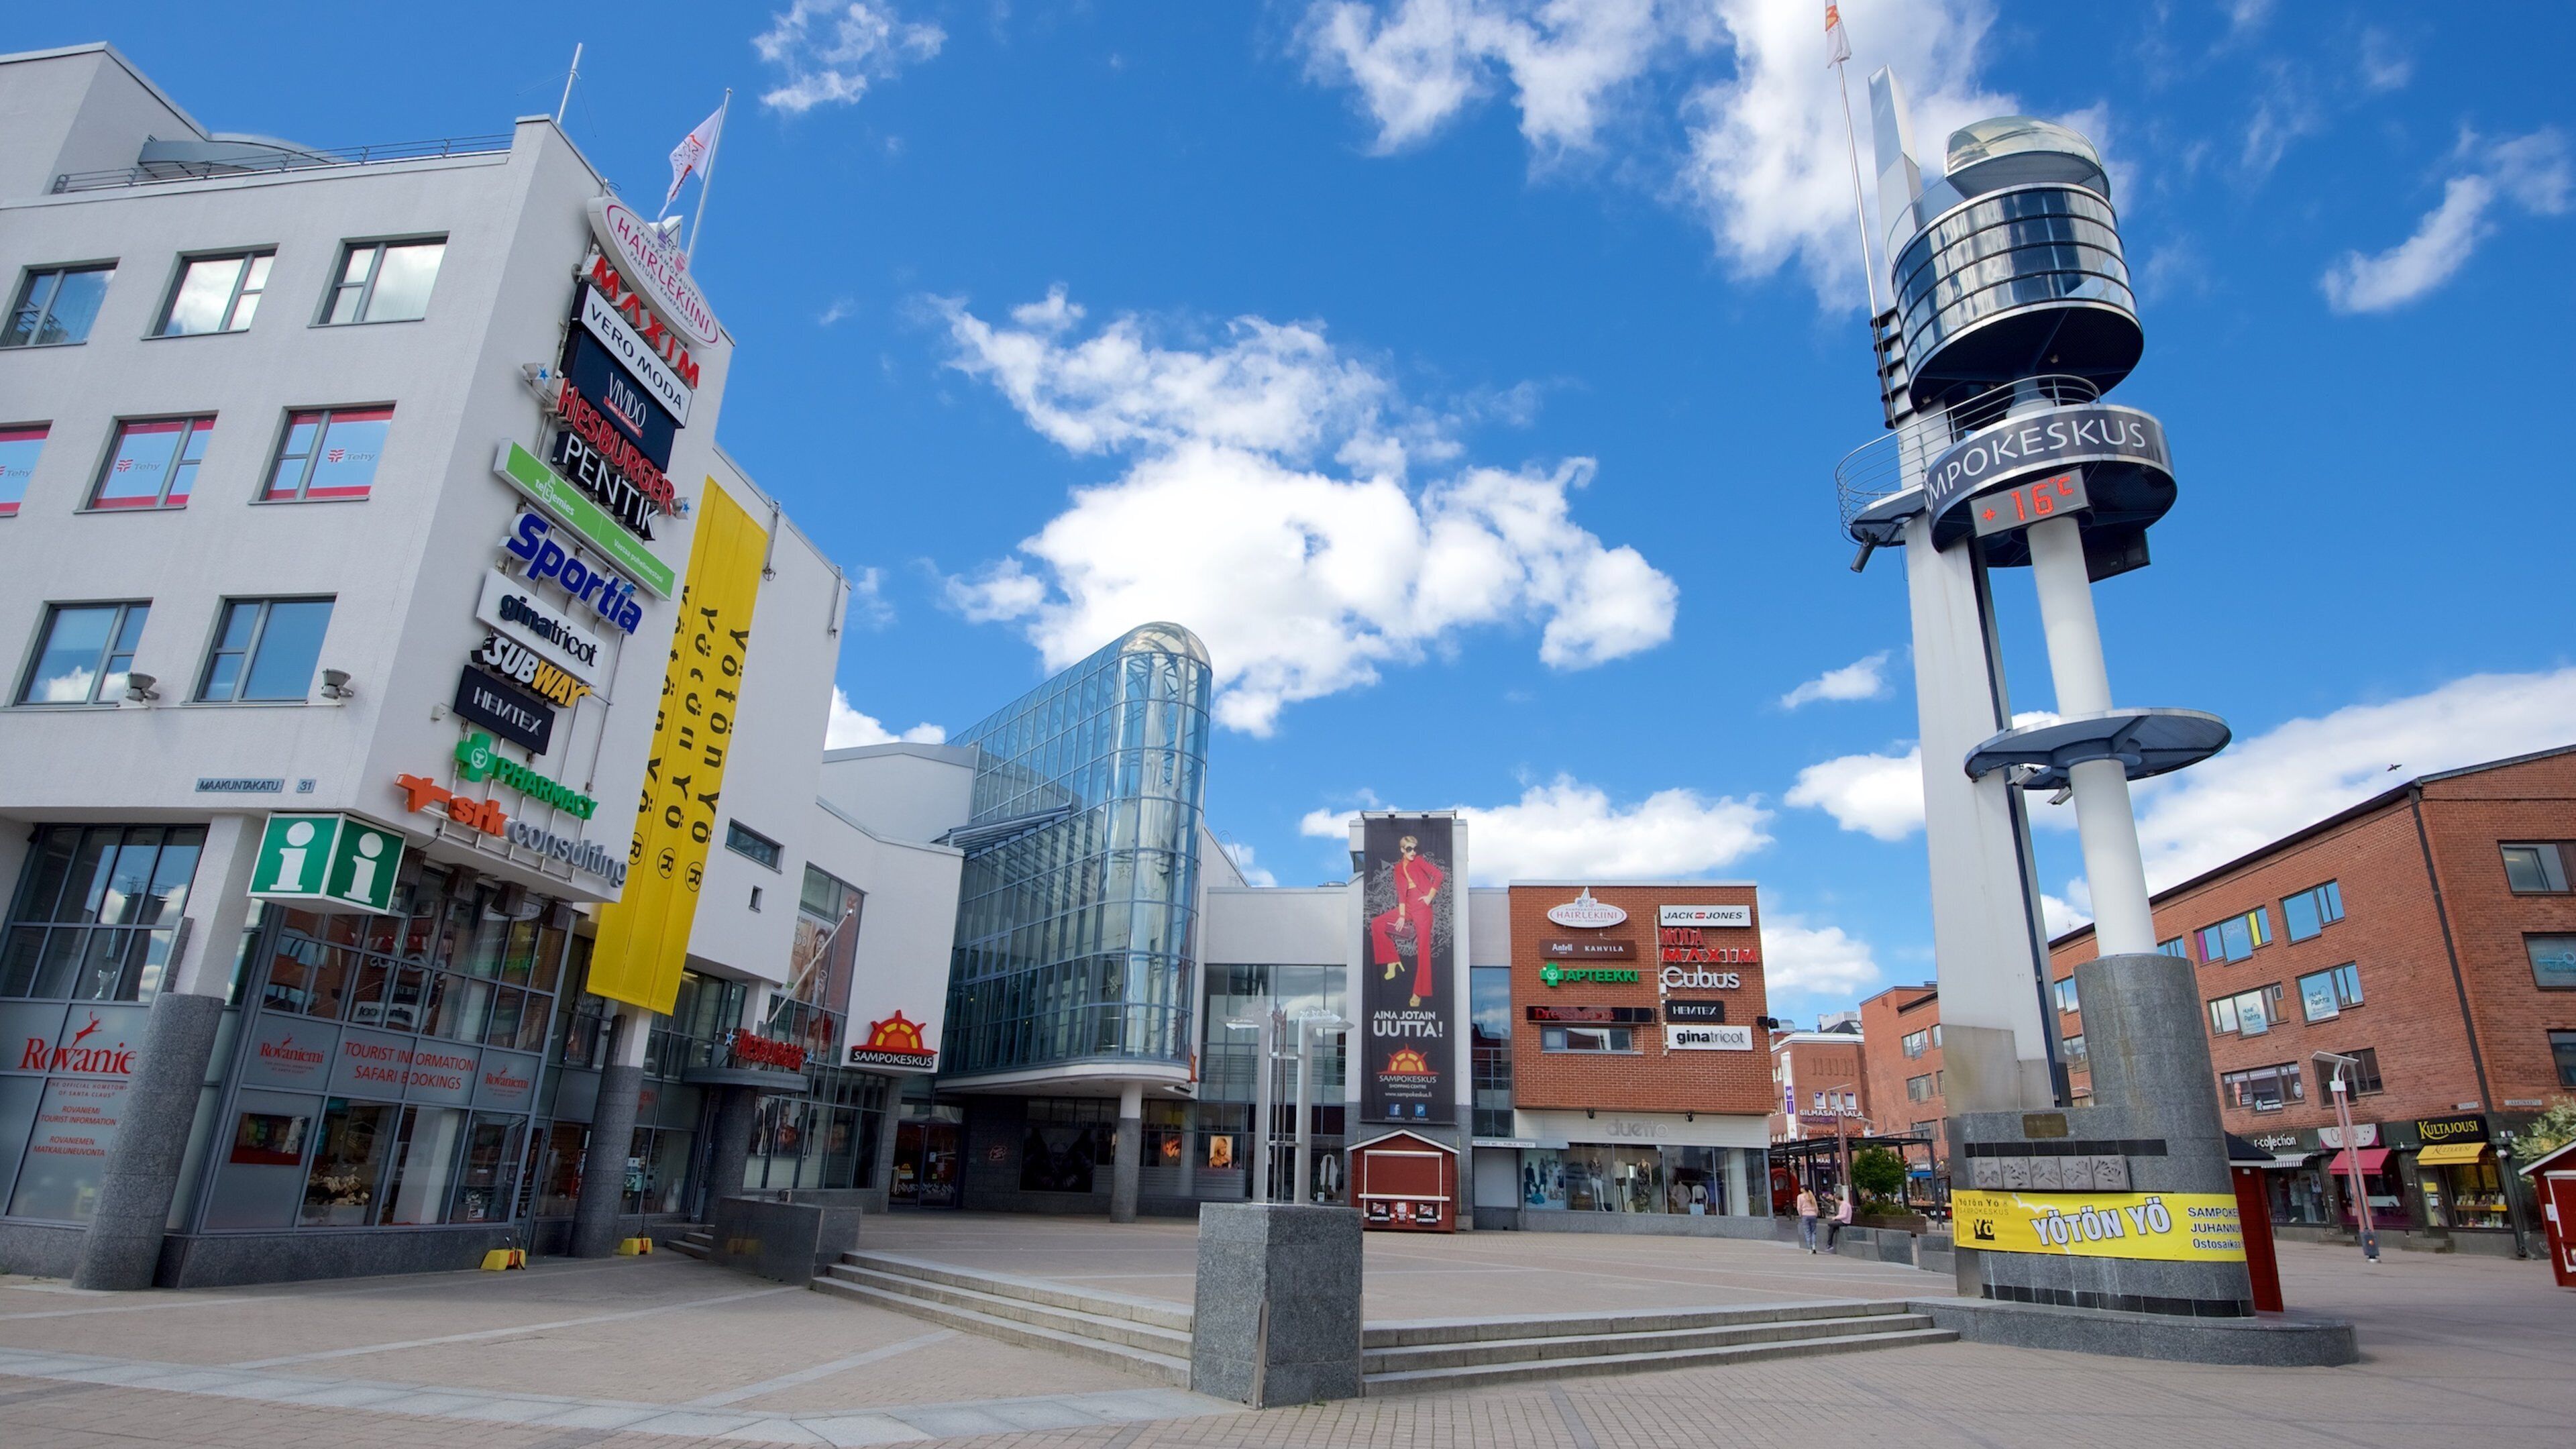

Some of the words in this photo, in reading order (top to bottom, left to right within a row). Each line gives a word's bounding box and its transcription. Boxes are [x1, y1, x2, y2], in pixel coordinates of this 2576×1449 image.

[618, 217, 710, 334] HAIRLEKIINI
[591, 303, 633, 358] VERO
[638, 357, 682, 410] MODA
[609, 372, 646, 427] VIVIDO
[556, 378, 675, 515] HESBURGER
[346, 451, 375, 462] Tehy
[6, 470, 32, 478] Tehy
[134, 463, 160, 471] Tehy
[563, 435, 659, 539] PENTIK
[506, 513, 642, 635] Sportia
[481, 635, 592, 708] SUBWAY
[473, 686, 542, 736] HEMTEX
[199, 780, 279, 791] MAAKUNTAKATU
[299, 781, 313, 791] 31
[494, 757, 598, 820] PHARMACY
[449, 796, 508, 837] srk
[508, 820, 628, 888] consulting
[1660, 928, 1703, 946] MODA
[1566, 969, 1639, 982] APTEEKKI
[1662, 965, 1740, 989] Cubus
[1373, 1011, 1397, 1020] AINA
[1399, 1011, 1436, 1020] JOTAIN
[1535, 1008, 1615, 1020] Dressmann
[1673, 1006, 1717, 1015] HEMTEX
[1373, 1020, 1443, 1038] UUTTA!
[18, 1038, 137, 1074] Rovanie
[260, 1042, 325, 1063] Rovaniemi
[345, 1042, 396, 1061] TOURIST
[737, 1028, 804, 1073] HESBURGER
[853, 1051, 933, 1067] SAMPOKESKUS
[354, 1065, 398, 1082] SAFARI
[401, 1071, 461, 1090] BOOKINGS
[1379, 1075, 1436, 1083] SAMPOKESKUS
[62, 1106, 101, 1114] ROVANIEMI
[40, 1115, 68, 1123] TOURIST
[69, 1116, 117, 1126] INFORMATION
[1606, 1118, 1669, 1138] duetto
[2418, 1121, 2479, 1139] KULTAJOUSI
[50, 1136, 95, 1145] ROVANIEMEN
[33, 1145, 105, 1157] MATKAILUNEUVONTA
[2030, 1204, 2125, 1246] YÖTÖN
[2127, 1196, 2172, 1236] YÖ
